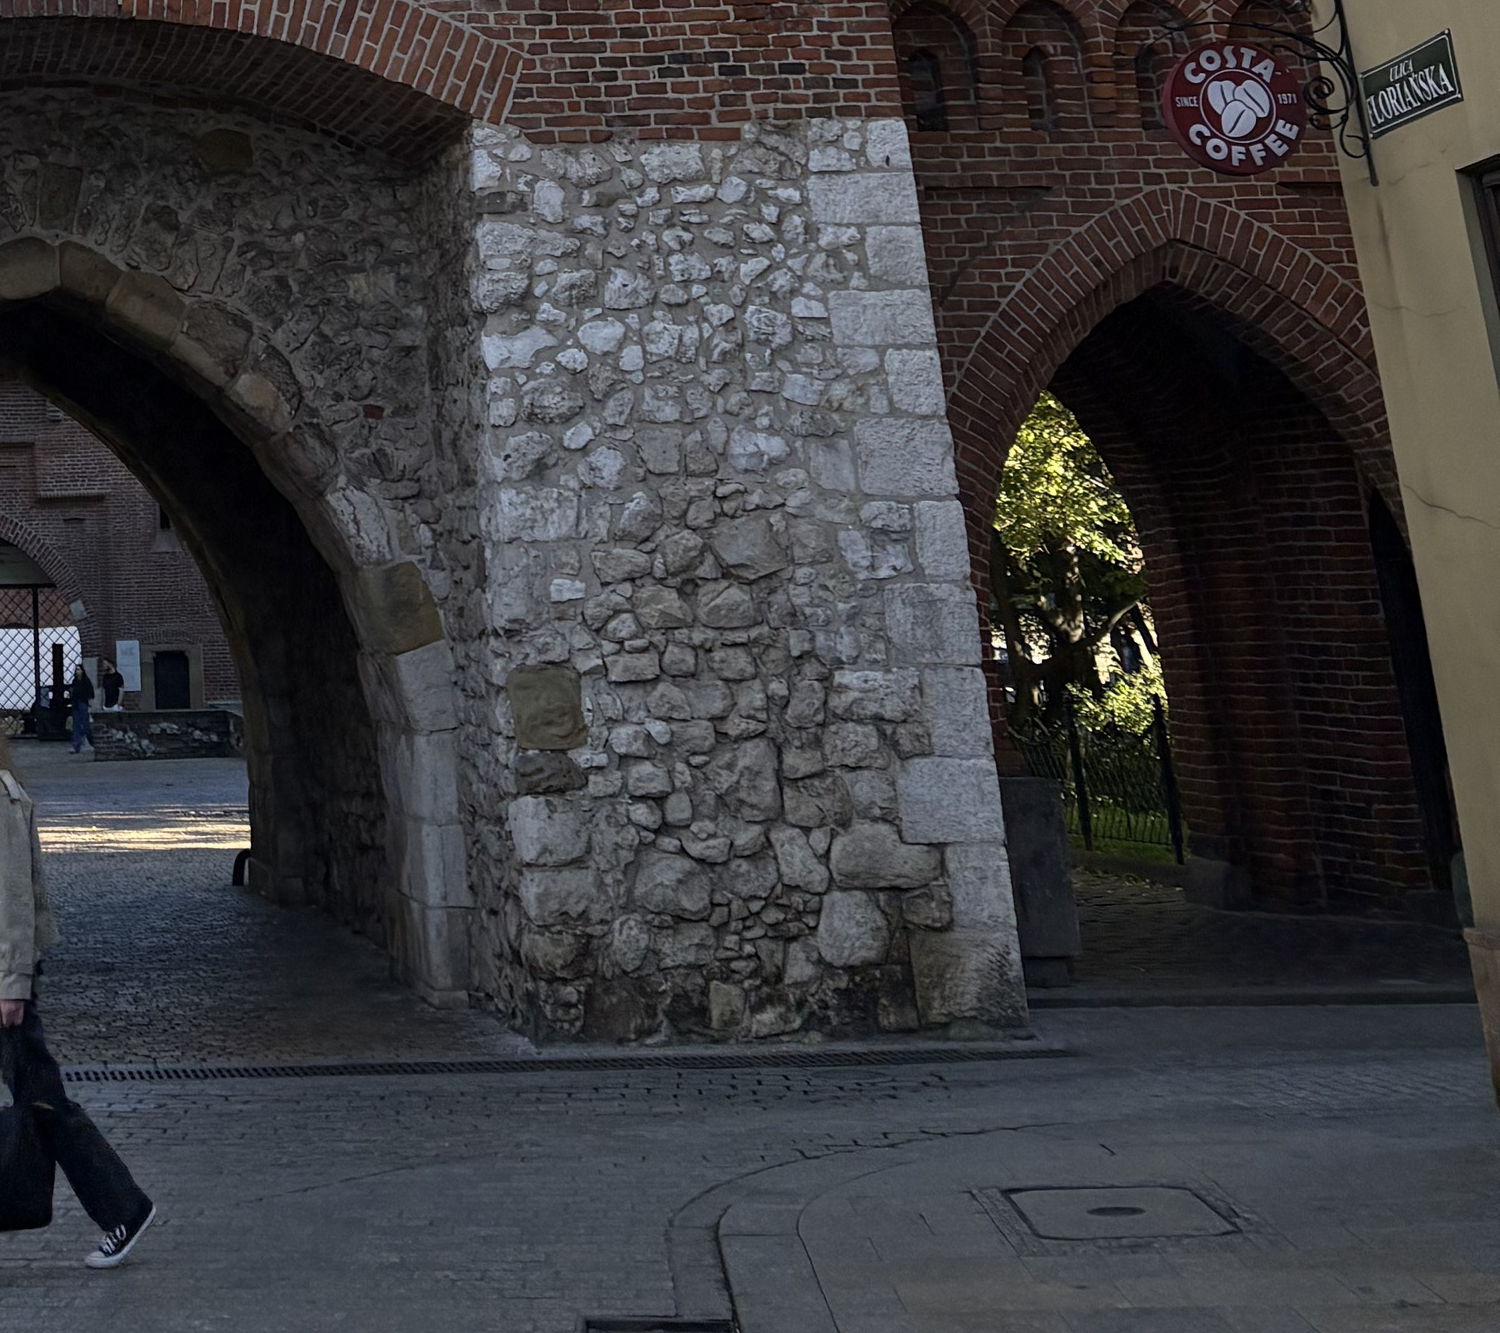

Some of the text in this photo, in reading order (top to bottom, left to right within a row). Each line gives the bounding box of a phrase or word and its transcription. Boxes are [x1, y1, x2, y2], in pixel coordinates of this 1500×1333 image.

[1184, 45, 1275, 83] COSTA
[1389, 58, 1414, 82] ULICA
[1175, 93, 1298, 108] SINCE 1971
[1366, 63, 1455, 128] FLORIAŃSKA
[1188, 119, 1299, 166] COFFEE
